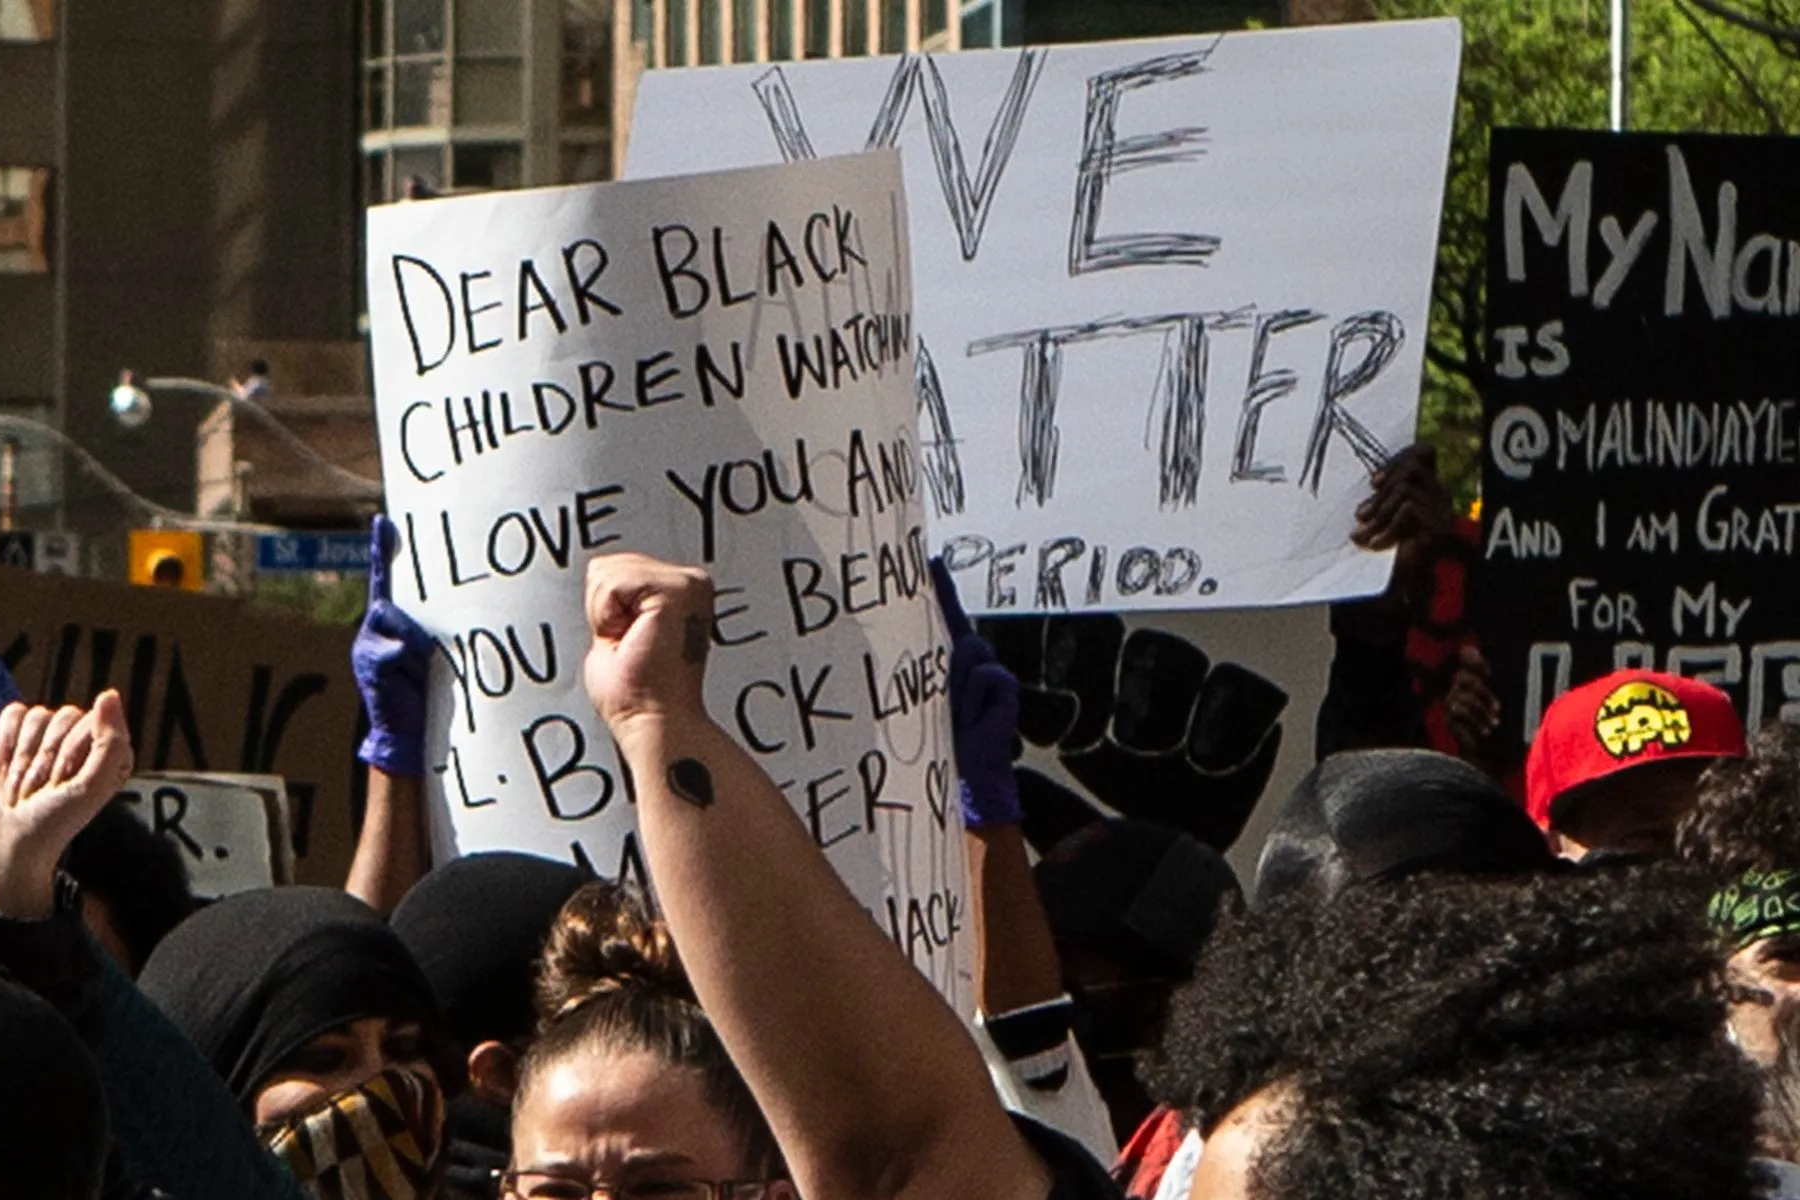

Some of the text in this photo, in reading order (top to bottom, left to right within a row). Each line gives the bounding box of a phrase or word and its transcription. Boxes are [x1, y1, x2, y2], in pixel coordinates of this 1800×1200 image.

[1664, 144, 1800, 319] Na
[393, 205, 868, 376] DEAR BLACK
[1494, 319, 1571, 379] IS
[400, 343, 748, 483] CHILDREN
[404, 428, 917, 601] I LOVE YOU AND
[1594, 500, 1607, 549] I
[941, 533, 1218, 611] PERIOD.
[433, 621, 558, 733] YOU
[864, 643, 949, 723] LIVES
